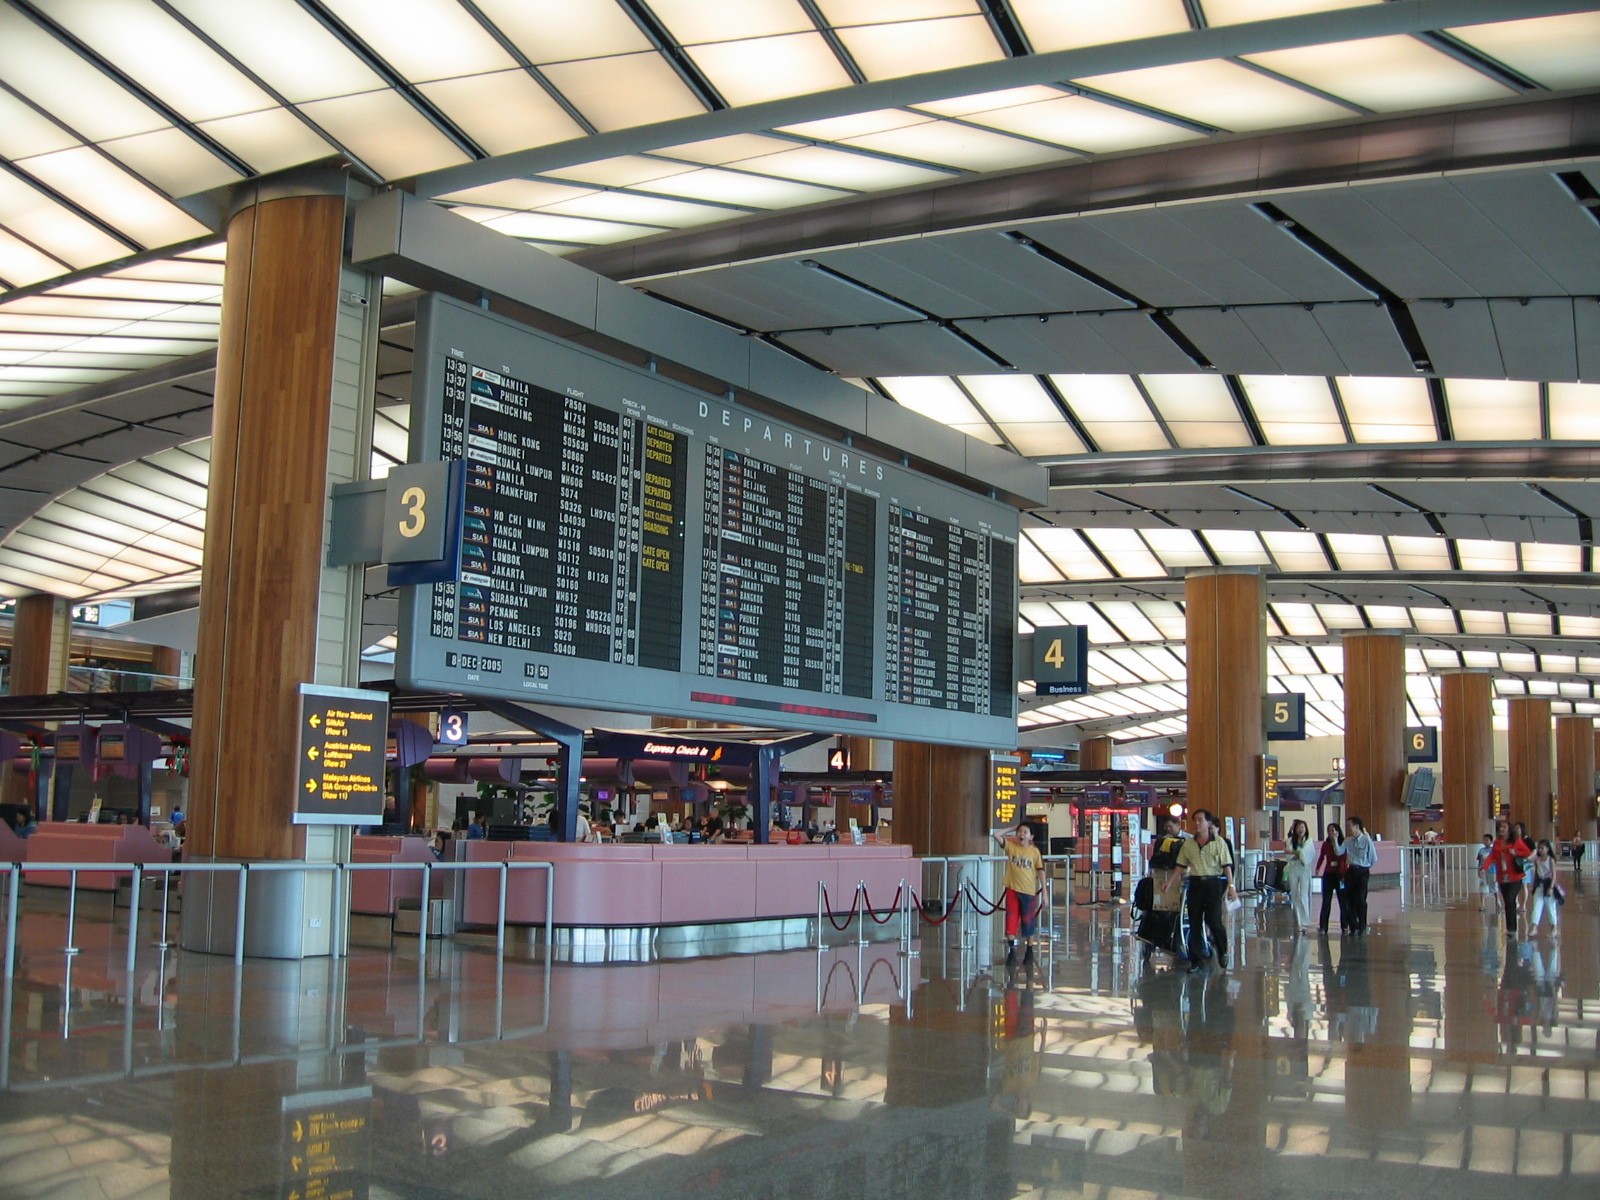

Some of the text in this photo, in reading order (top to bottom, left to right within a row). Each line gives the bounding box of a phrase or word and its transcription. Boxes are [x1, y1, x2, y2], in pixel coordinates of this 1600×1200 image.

[450, 348, 465, 359] TIME
[502, 365, 511, 374] TO
[447, 358, 466, 374] 13:30
[500, 376, 528, 394] MANILA
[647, 425, 658, 436] GATE
[567, 387, 585, 399] FLIGHT
[446, 372, 465, 387] 13:37
[500, 389, 528, 407] PHUKET
[646, 436, 672, 452] DEPARTED
[646, 414, 669, 428] REMARKS
[446, 386, 464, 401] 13:33
[498, 403, 532, 421] KUCHING
[646, 448, 672, 464] DEPARTED
[444, 413, 671, 488] 13:47 SIA HONG KONG DEPARTED
[699, 401, 885, 481] DEPARTURES
[443, 427, 462, 442] 13:56
[496, 442, 524, 459] BRUNEI
[644, 484, 670, 499] DEPARTED
[442, 440, 462, 455] 13:45
[496, 456, 520, 471] KUALA
[525, 464, 552, 480] LUMPUR
[644, 497, 655, 507] GATE
[475, 465, 487, 473] SIA
[496, 469, 524, 486] MANILA
[644, 509, 654, 519] GATE
[399, 486, 427, 539] 3
[475, 478, 486, 487] SIA
[495, 483, 537, 502] FRANKFURT
[643, 520, 668, 535] BOARDING
[473, 505, 484, 514] SIA
[494, 510, 503, 521] HO
[508, 513, 521, 525] CHI
[527, 518, 545, 531] MINH
[642, 545, 655, 556] GATE
[472, 533, 548, 558] SIA KUALA LUMPUR
[493, 523, 522, 539] YANGON
[642, 557, 655, 568] GATE
[492, 550, 520, 566] LOMBOK
[471, 560, 524, 580] SIA JAKARTA
[435, 582, 454, 594] 15:35
[490, 591, 528, 607] SURABAYA
[490, 578, 514, 592] KUALA
[519, 583, 547, 598] LUMPUR
[434, 595, 454, 608] 15:40
[469, 602, 480, 610] SIA
[489, 605, 518, 619] PENANG
[433, 609, 540, 636] 16:00 SIA LOS ANGELES
[433, 623, 530, 648] 16:20 SIA NEW DELHI
[451, 654, 503, 673] 8-DEC-2005
[1044, 638, 1065, 669] 4
[467, 674, 481, 682] DATE
[526, 665, 549, 678] 13:58
[523, 681, 539, 689] LOCAL
[1049, 685, 1083, 694] Business
[326, 709, 374, 721] Air New Zealand
[1274, 702, 1290, 724] 5
[325, 727, 341, 737] (Row
[446, 714, 463, 742] 3
[324, 742, 372, 752] Austrian Airlines
[643, 743, 676, 754] Express
[676, 745, 700, 756] Check
[1412, 733, 1425, 750] 6
[323, 760, 339, 769] (Row
[324, 751, 353, 760] Lufthansa
[831, 750, 845, 770] 4
[322, 783, 334, 791] SIA
[334, 783, 353, 793] Group
[323, 773, 372, 783] Malaysia Airlines
[322, 791, 338, 800] (Row
